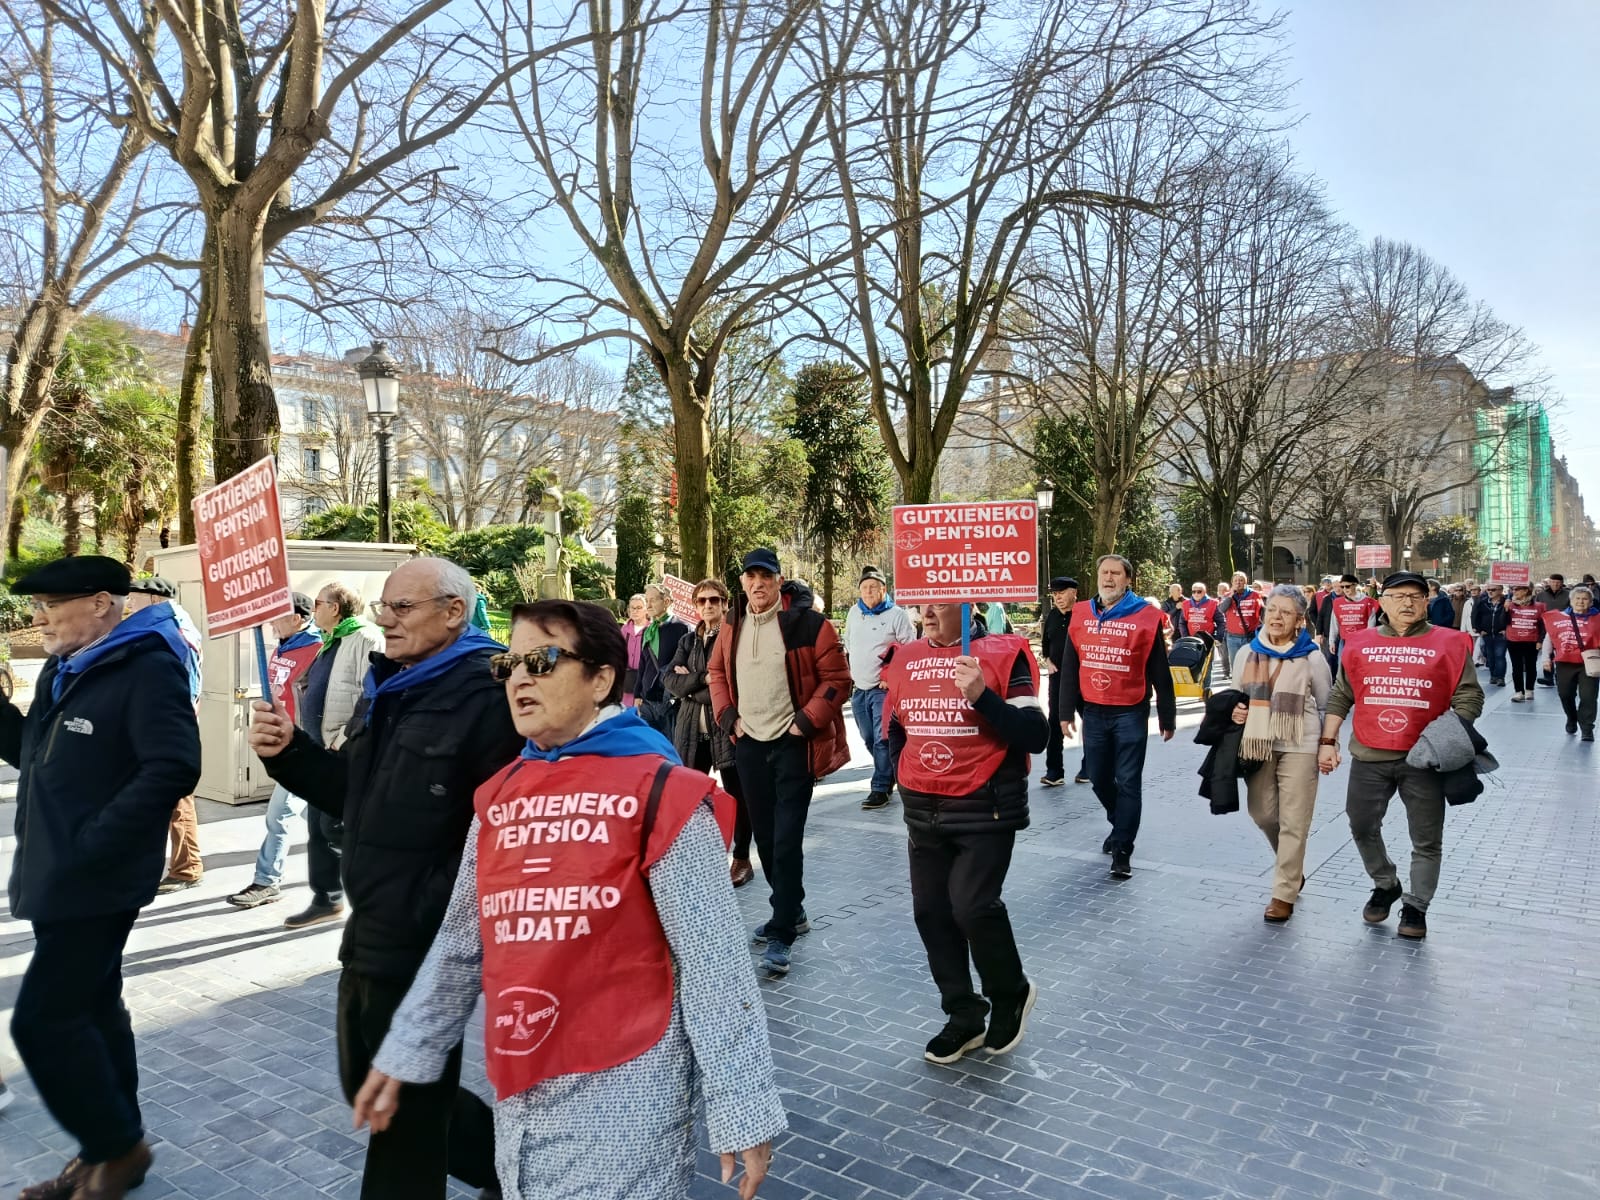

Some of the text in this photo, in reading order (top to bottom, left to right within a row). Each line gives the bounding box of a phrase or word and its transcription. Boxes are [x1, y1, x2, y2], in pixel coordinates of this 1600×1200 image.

[200, 467, 273, 523] GUTXIENEKO
[213, 499, 268, 541] PENTSIOA
[902, 505, 1034, 525] GUTXIENEKO
[924, 524, 1018, 541] PENTSIOA
[208, 536, 279, 583] GUTXIENEKO
[907, 550, 1031, 568] GUTXIENEKO
[926, 568, 1013, 583] SOLDATA
[223, 566, 274, 602] SOLDATA
[667, 578, 694, 593] GUTXIE
[1083, 619, 1137, 631] GUTIENEKO
[1080, 644, 1131, 656] GUTXIENEKO
[1361, 646, 1436, 658] GUTXIENEKO
[906, 656, 980, 670] GUTXIENE
[1085, 652, 1122, 663] SOLDATA
[1368, 654, 1426, 665] PENTSIOA
[910, 668, 957, 681] PENTSIO
[1363, 676, 1433, 689] GUTXIENEKO
[1369, 685, 1421, 698] SOLDATA
[908, 711, 964, 723] SOLDATA
[486, 792, 639, 827] GUTXIENEKO
